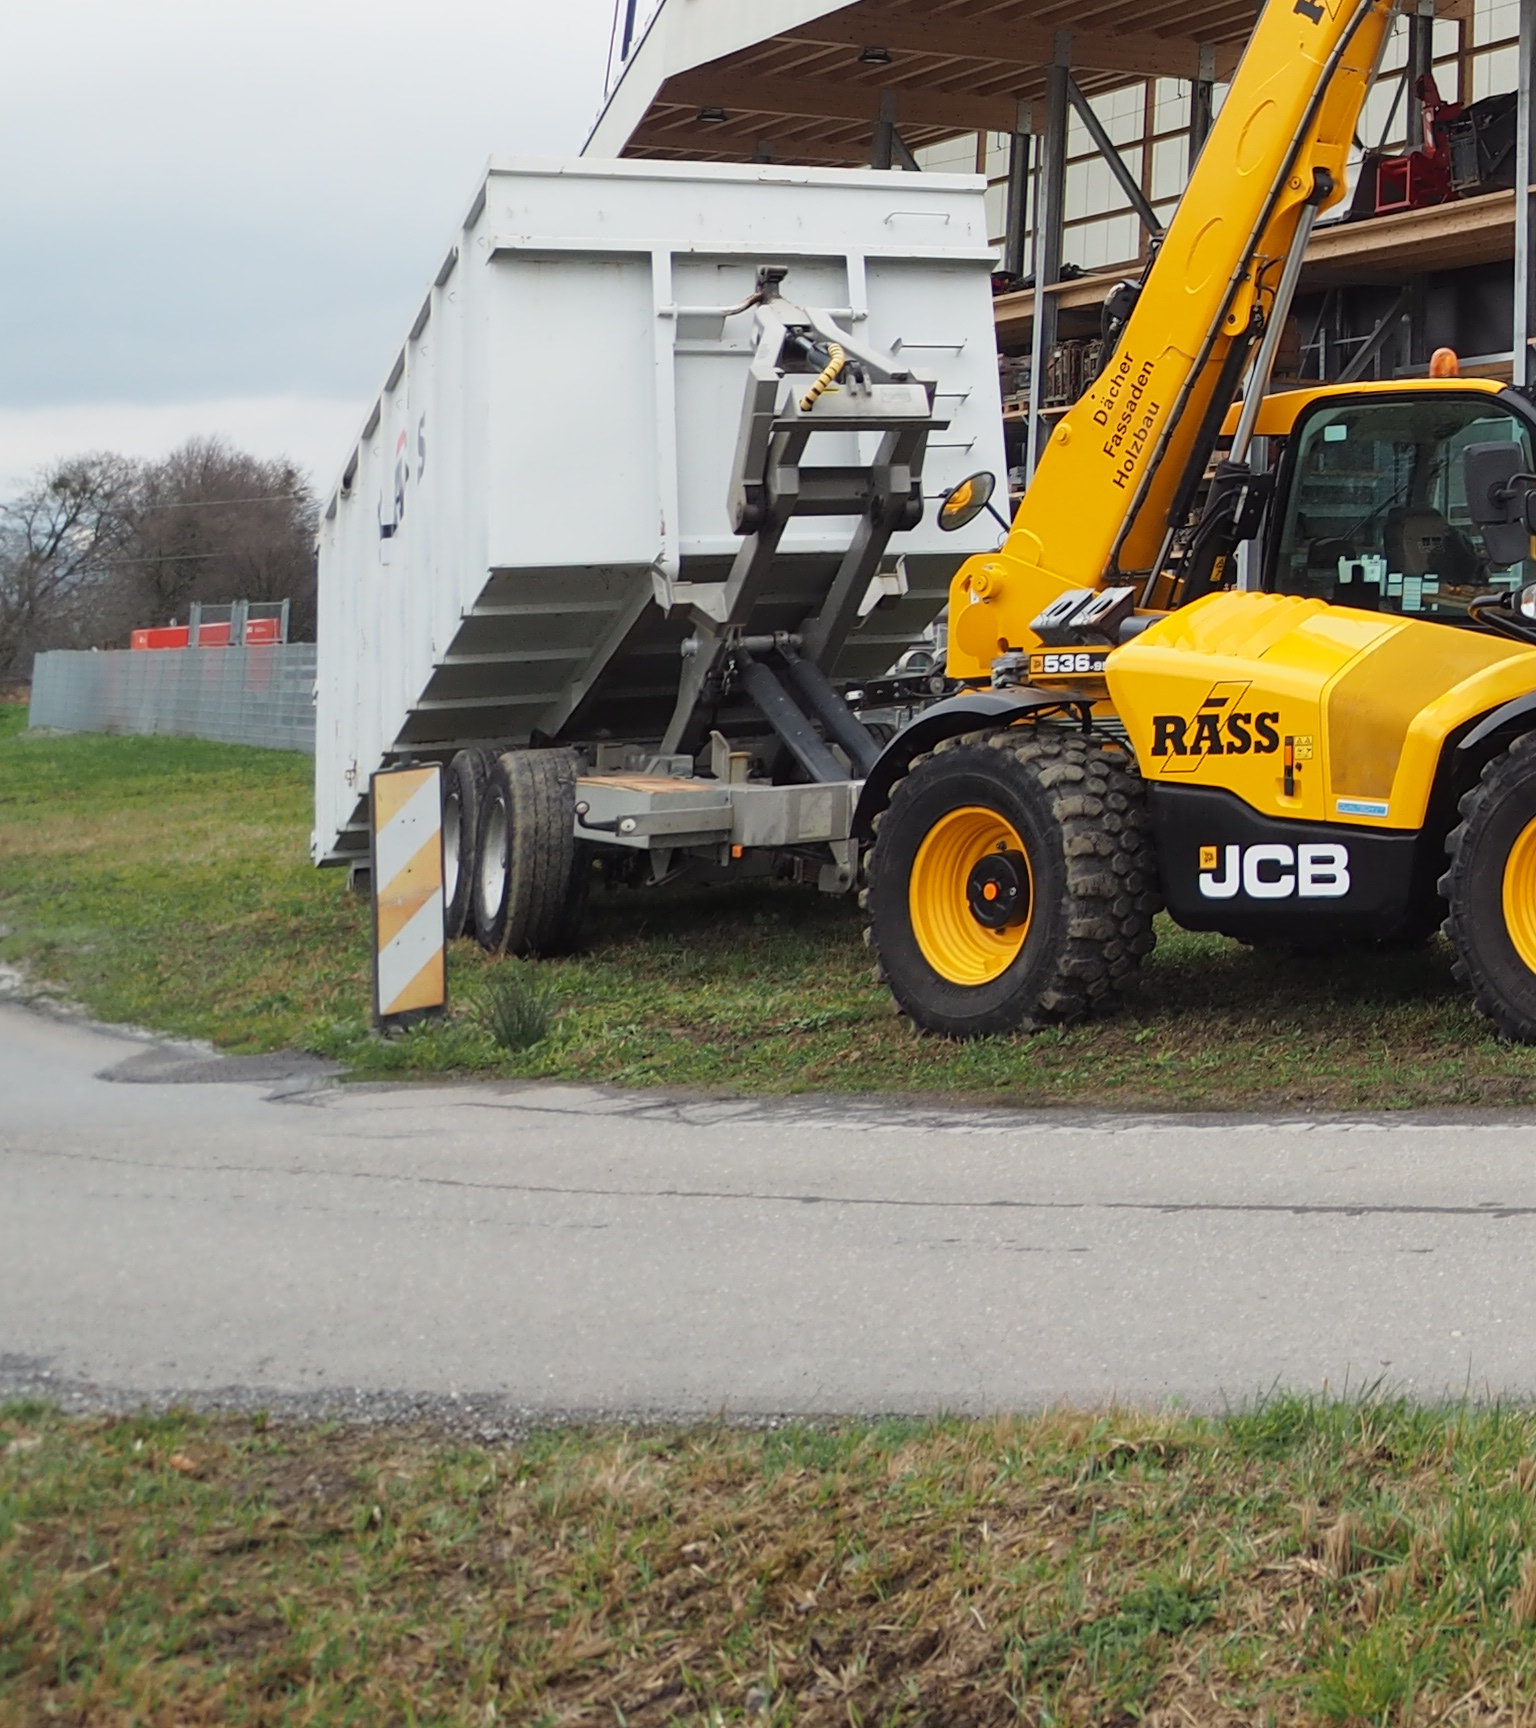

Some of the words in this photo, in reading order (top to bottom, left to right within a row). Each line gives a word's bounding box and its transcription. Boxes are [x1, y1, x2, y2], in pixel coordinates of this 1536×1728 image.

[1093, 351, 1134, 427] Dächer
[1102, 359, 1155, 459] Fassaden
[1112, 400, 1160, 490] Holzbau
[1199, 843, 1351, 898] JCB
